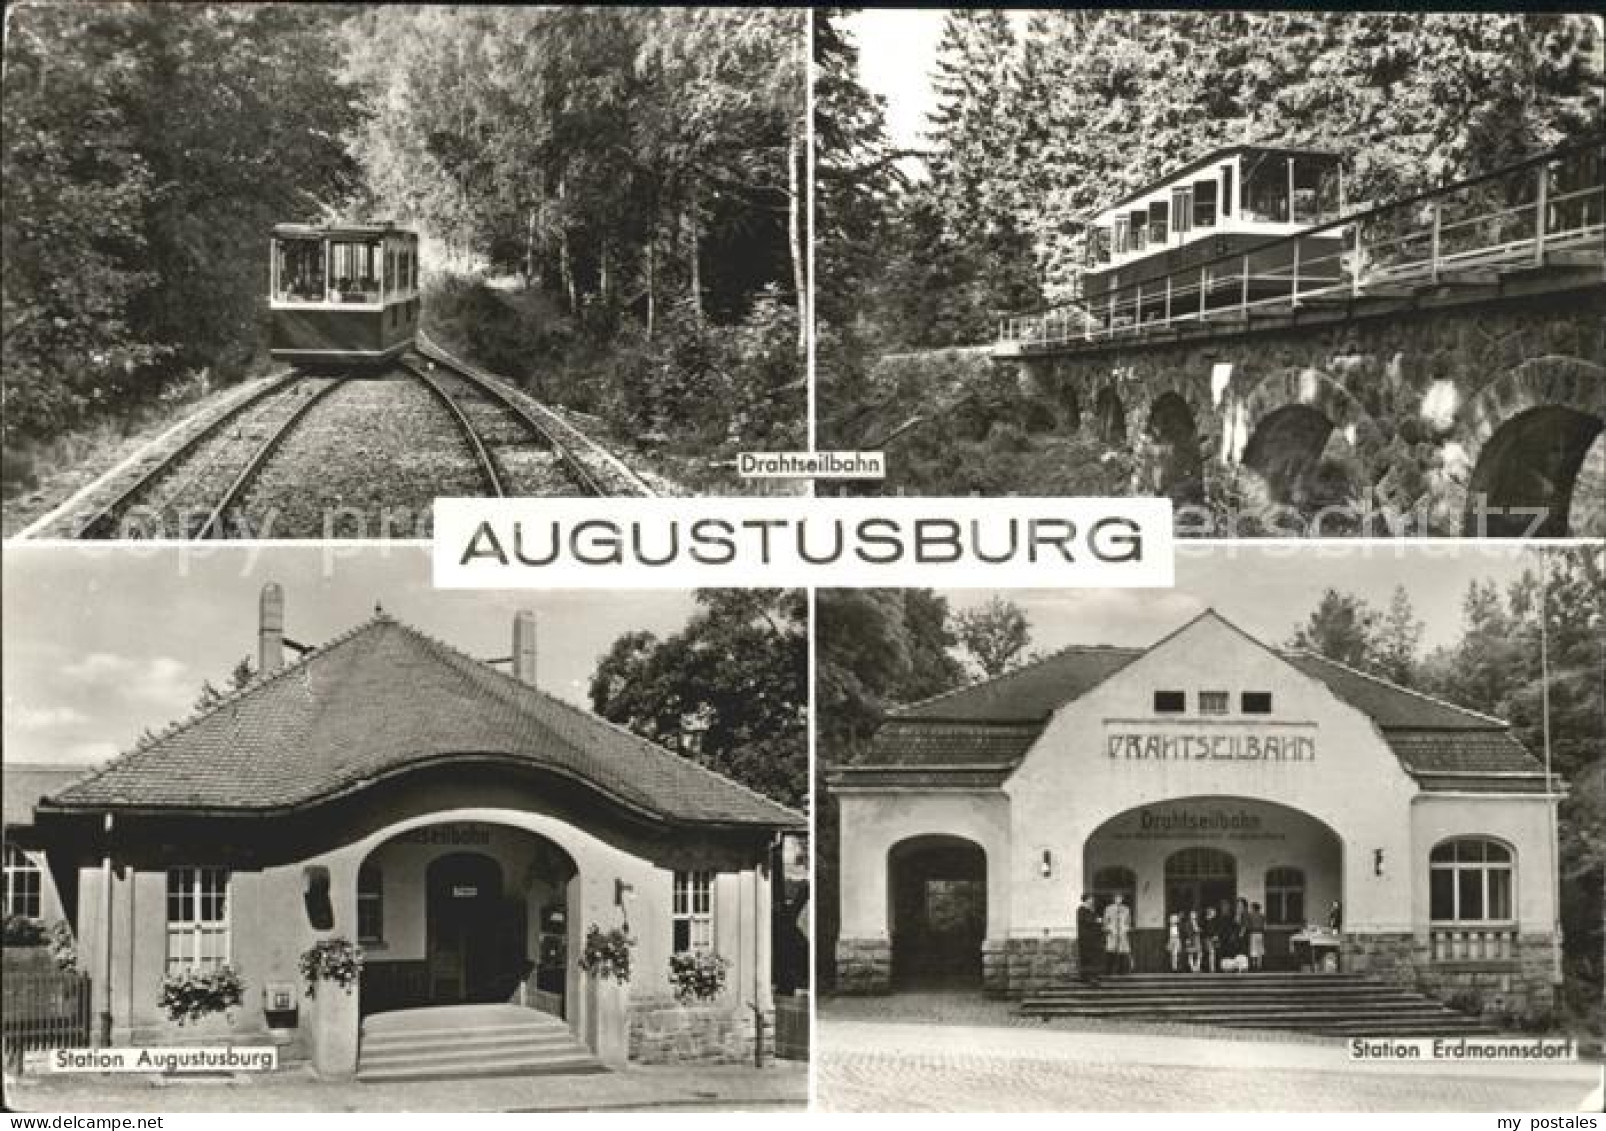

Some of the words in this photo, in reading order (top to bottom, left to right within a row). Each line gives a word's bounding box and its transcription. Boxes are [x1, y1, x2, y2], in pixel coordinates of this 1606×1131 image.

[743, 452, 880, 473] Drahtseilbahn
[459, 517, 1143, 566] AUGUSTUSBURG
[1106, 734, 1316, 762] DRAHTSEILBAHN
[55, 1050, 125, 1068] Station
[136, 1049, 273, 1073] Augustusburg
[1352, 1039, 1421, 1059] Station
[1432, 1039, 1572, 1059] Erdmannsdorf
